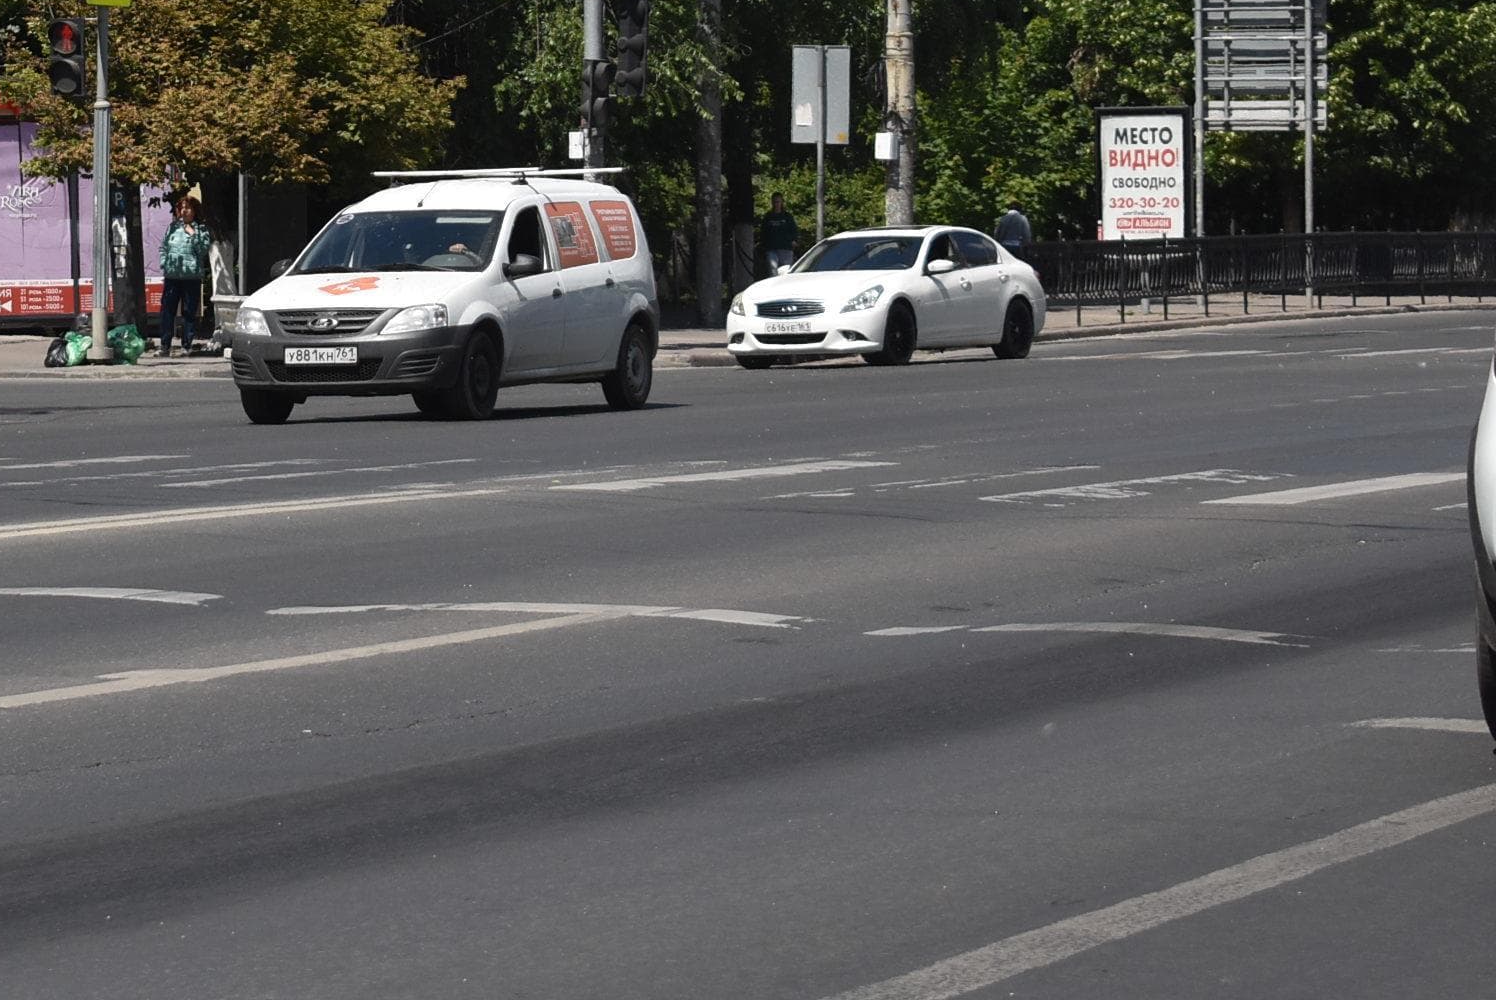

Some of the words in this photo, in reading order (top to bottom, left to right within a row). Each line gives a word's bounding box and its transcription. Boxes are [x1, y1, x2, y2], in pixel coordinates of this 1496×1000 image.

[1114, 126, 1173, 145] МЕСТО
[1108, 148, 1180, 171] ВИДНО!
[1112, 177, 1176, 191] СВОБОДНО
[1109, 197, 1180, 208] 320-30-20
